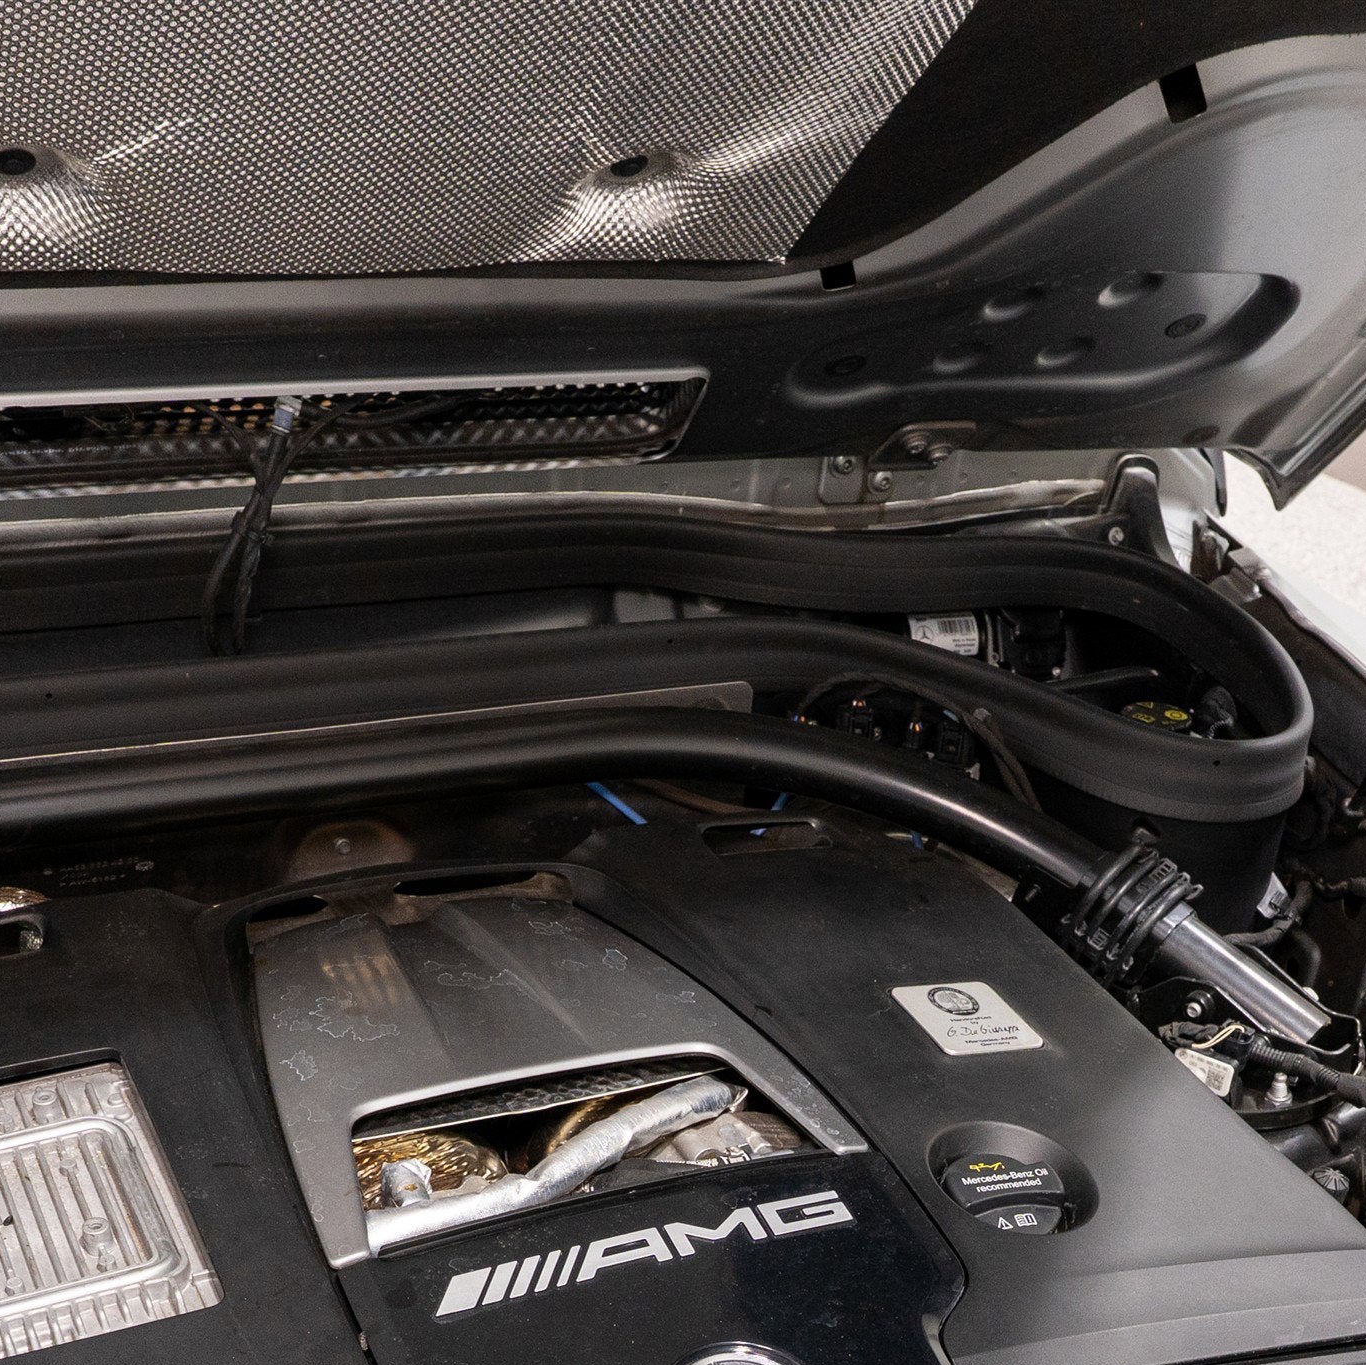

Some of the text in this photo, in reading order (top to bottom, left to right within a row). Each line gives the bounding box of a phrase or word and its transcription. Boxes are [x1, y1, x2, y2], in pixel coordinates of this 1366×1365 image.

[961, 1167, 1049, 1186] Mercedes-Benz Oil
[976, 1178, 1042, 1193] recommended
[576, 1190, 856, 1283] AMG
